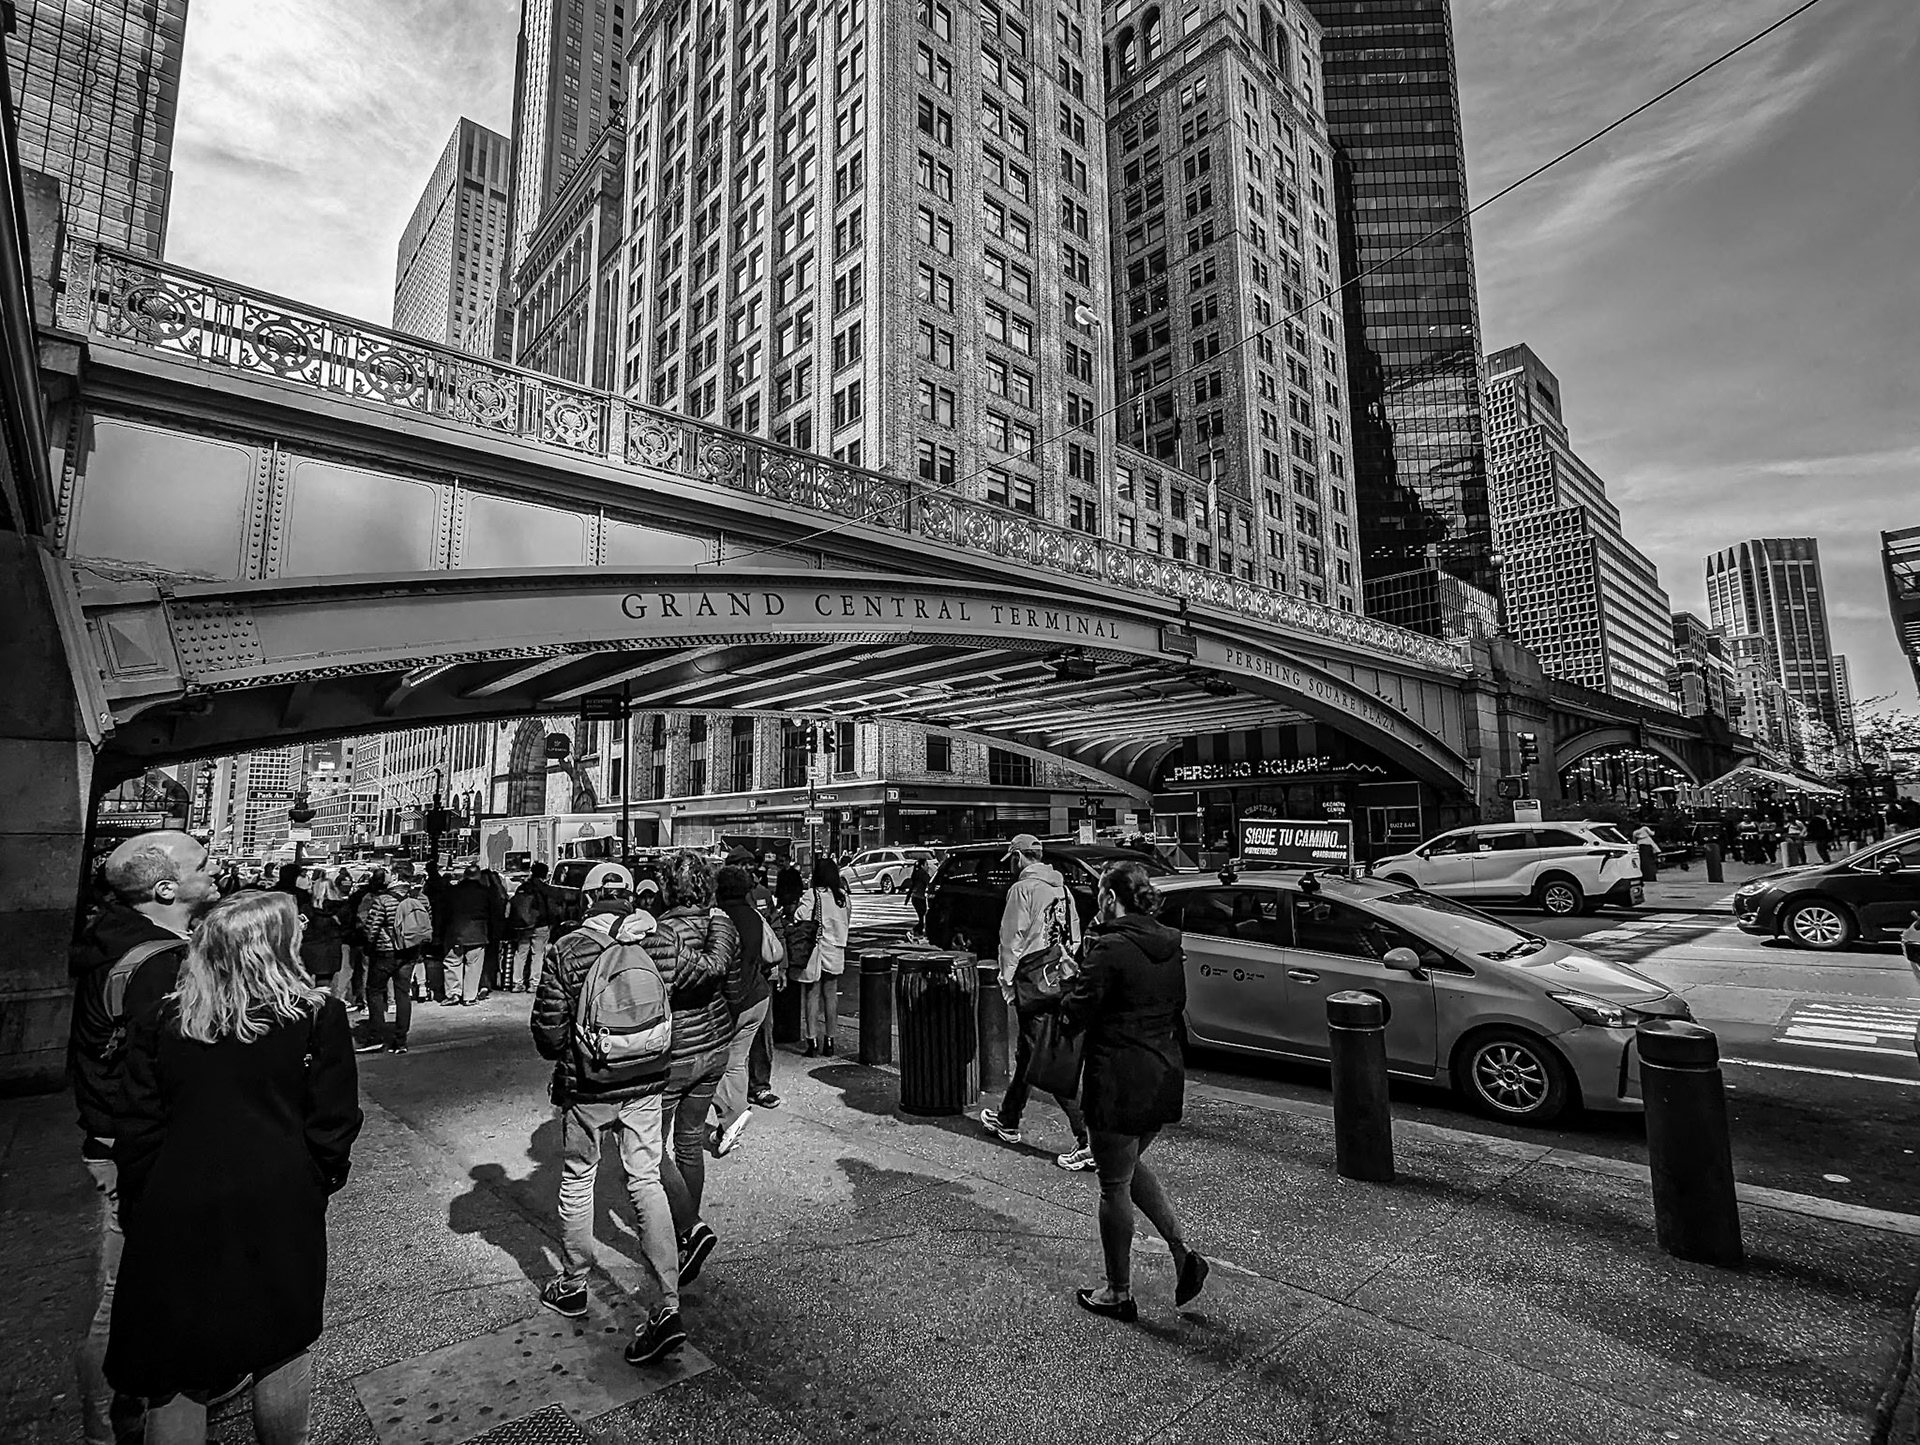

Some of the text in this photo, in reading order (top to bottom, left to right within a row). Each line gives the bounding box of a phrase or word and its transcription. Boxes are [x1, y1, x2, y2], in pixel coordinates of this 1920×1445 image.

[621, 592, 1120, 640] GRAND CENTRAL TERMINAL
[1226, 648, 1397, 732] PERSHING SQUARE PLAZA
[1174, 756, 1331, 781] PERSHING SQUARE
[888, 790, 898, 799] TD
[842, 812, 850, 821] TD
[1245, 827, 1347, 849] SIGUE TU CAMINO...
